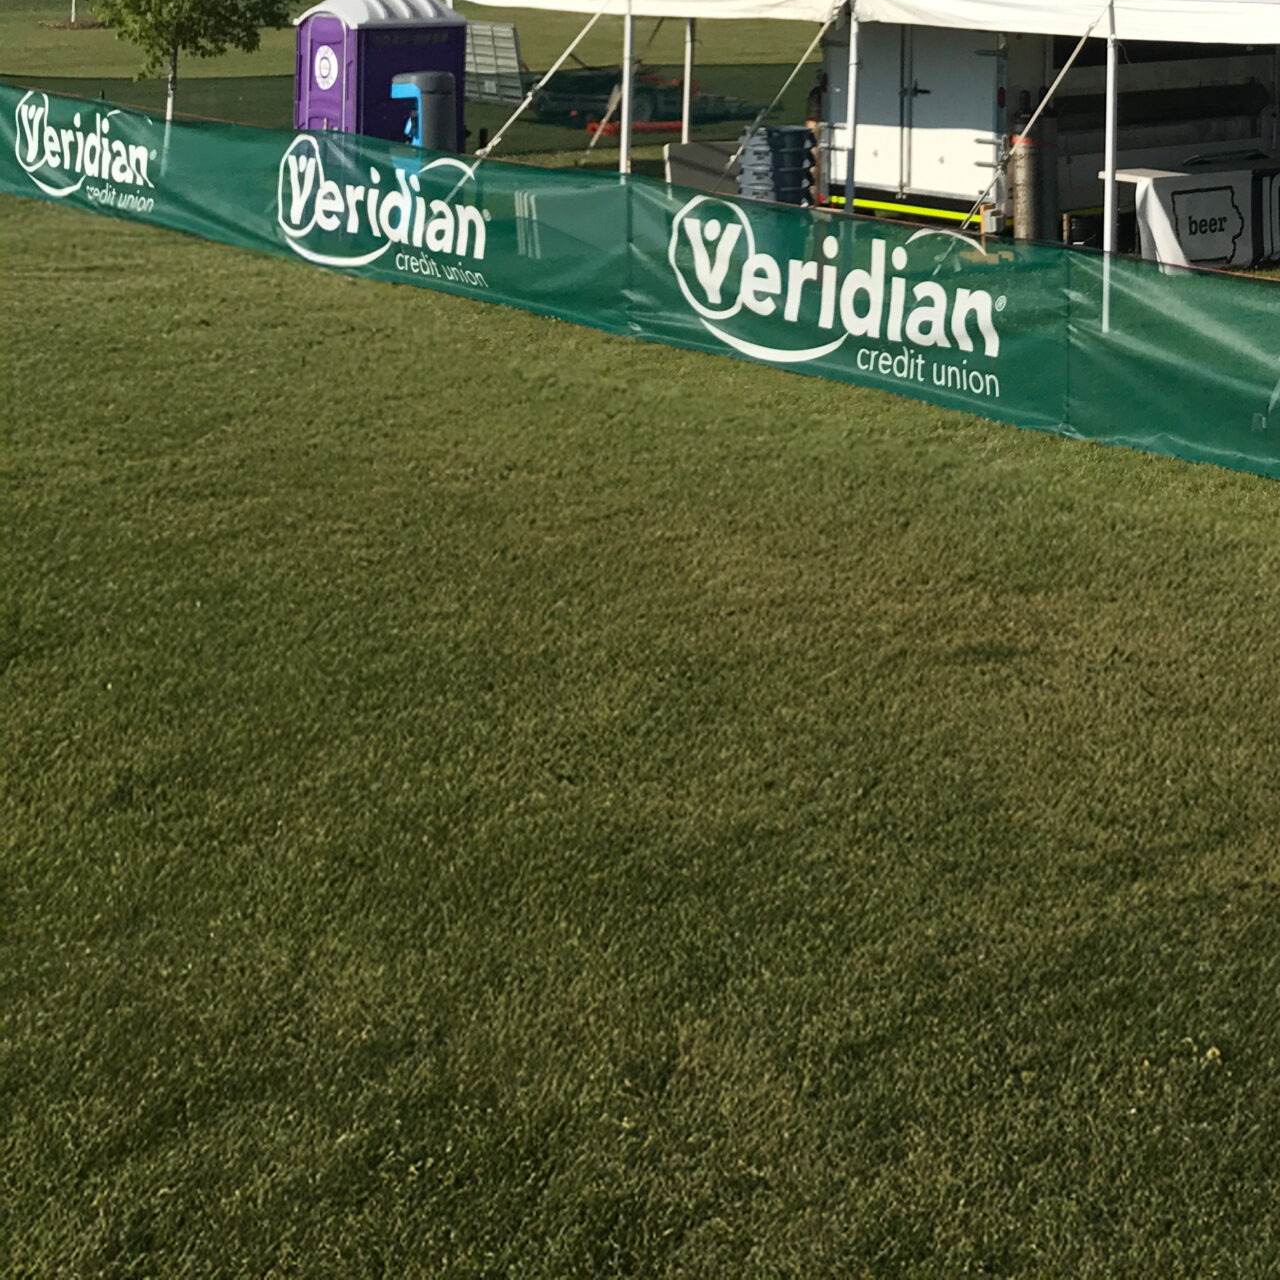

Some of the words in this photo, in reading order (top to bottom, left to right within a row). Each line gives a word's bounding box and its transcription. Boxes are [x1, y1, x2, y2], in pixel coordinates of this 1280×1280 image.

[21, 104, 154, 187] Veridian
[117, 189, 154, 213] union
[288, 155, 487, 260] Veridian
[1188, 215, 1227, 235] beer
[396, 251, 441, 278] credit
[441, 261, 489, 288] union
[683, 217, 1000, 358] Veridian
[857, 346, 924, 382] credit
[932, 359, 1000, 398] union
